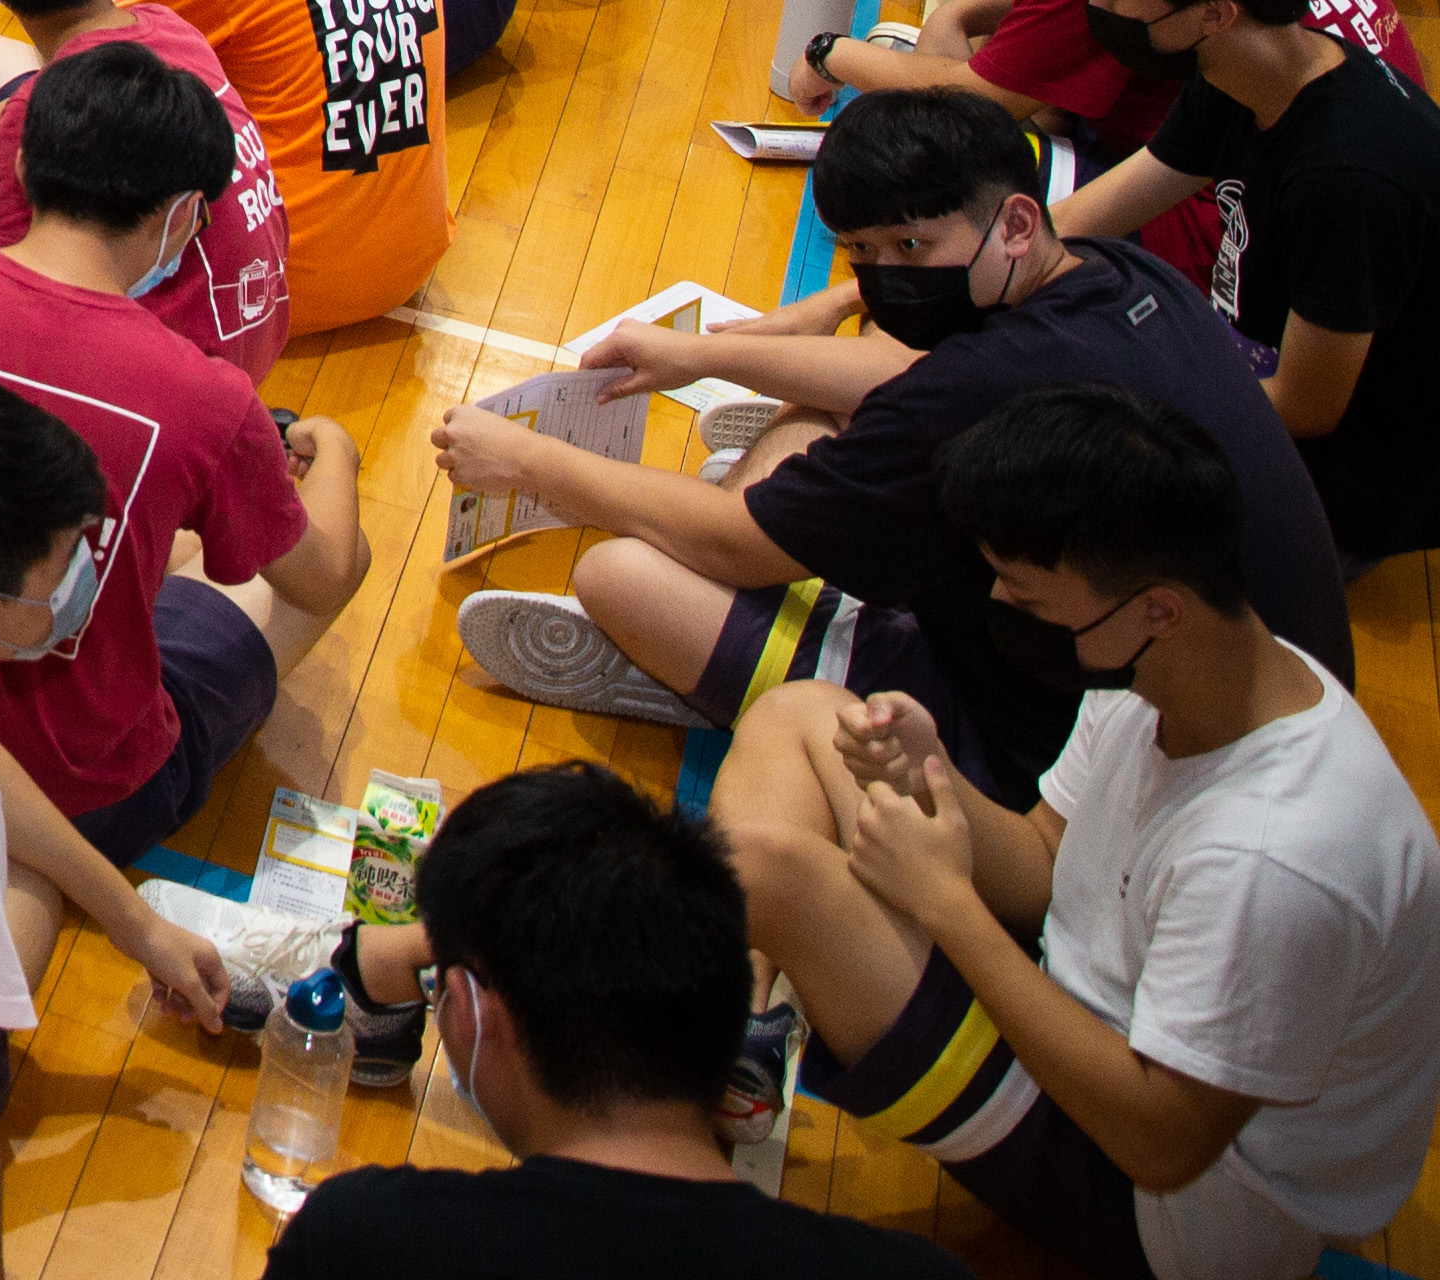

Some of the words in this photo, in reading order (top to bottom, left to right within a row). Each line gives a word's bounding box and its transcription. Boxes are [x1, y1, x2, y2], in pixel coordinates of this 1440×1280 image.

[327, 13, 421, 84] FOUR
[326, 74, 415, 154] EVER
[231, 119, 266, 182] OU
